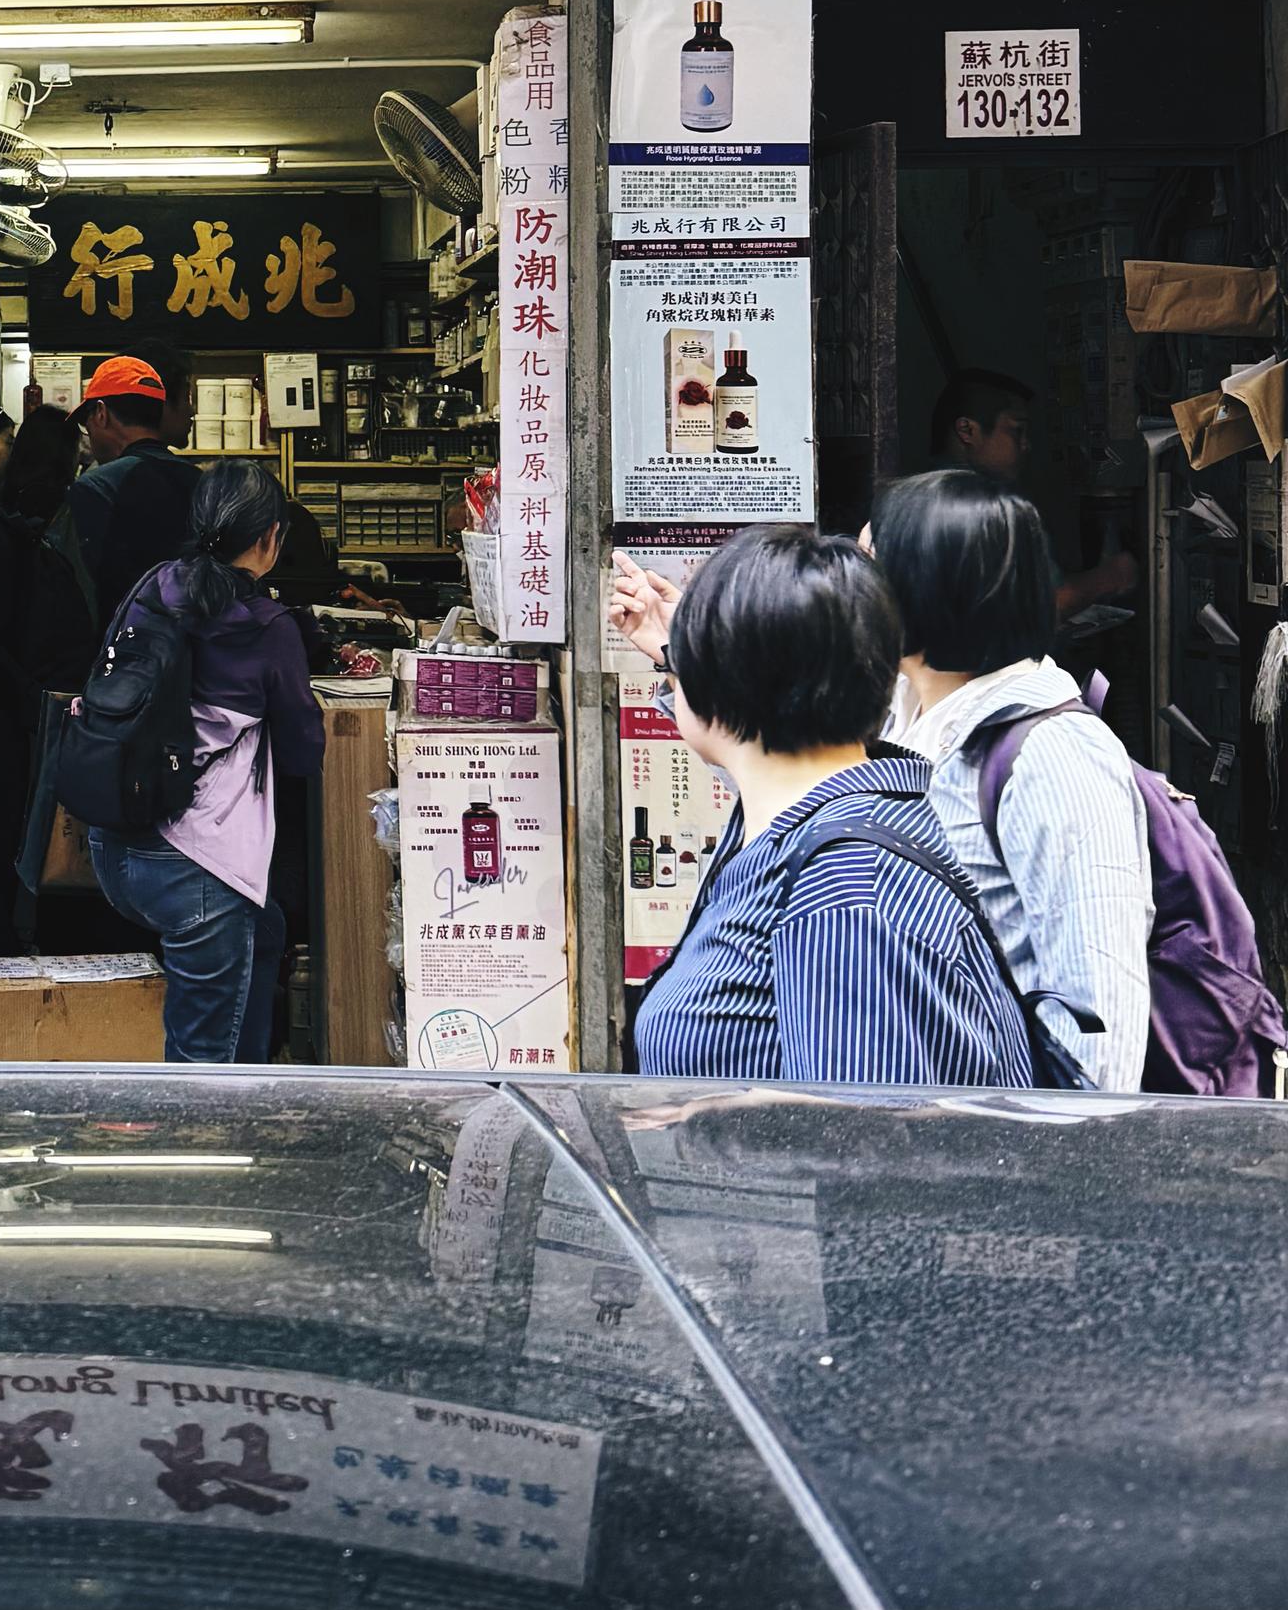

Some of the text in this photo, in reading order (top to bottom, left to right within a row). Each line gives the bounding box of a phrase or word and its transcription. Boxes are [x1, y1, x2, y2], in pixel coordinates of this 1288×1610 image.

[960, 39, 1071, 70] 蘇杭街
[524, 19, 556, 112] 食品用
[958, 72, 1072, 87] JERVOIS STREET
[957, 88, 1070, 128] 130-132
[666, 155, 683, 163] Rose
[715, 155, 743, 163] Essence
[631, 215, 787, 235] 兆成行有限公司
[513, 207, 560, 340] 防潮珠
[661, 291, 758, 306] 兆成清爽美白
[415, 745, 541, 756] SHIU SHING HONG Ltd.
[419, 923, 546, 941] 兆成薰衣草香薰油
[509, 1047, 556, 1064] 防潮珠
